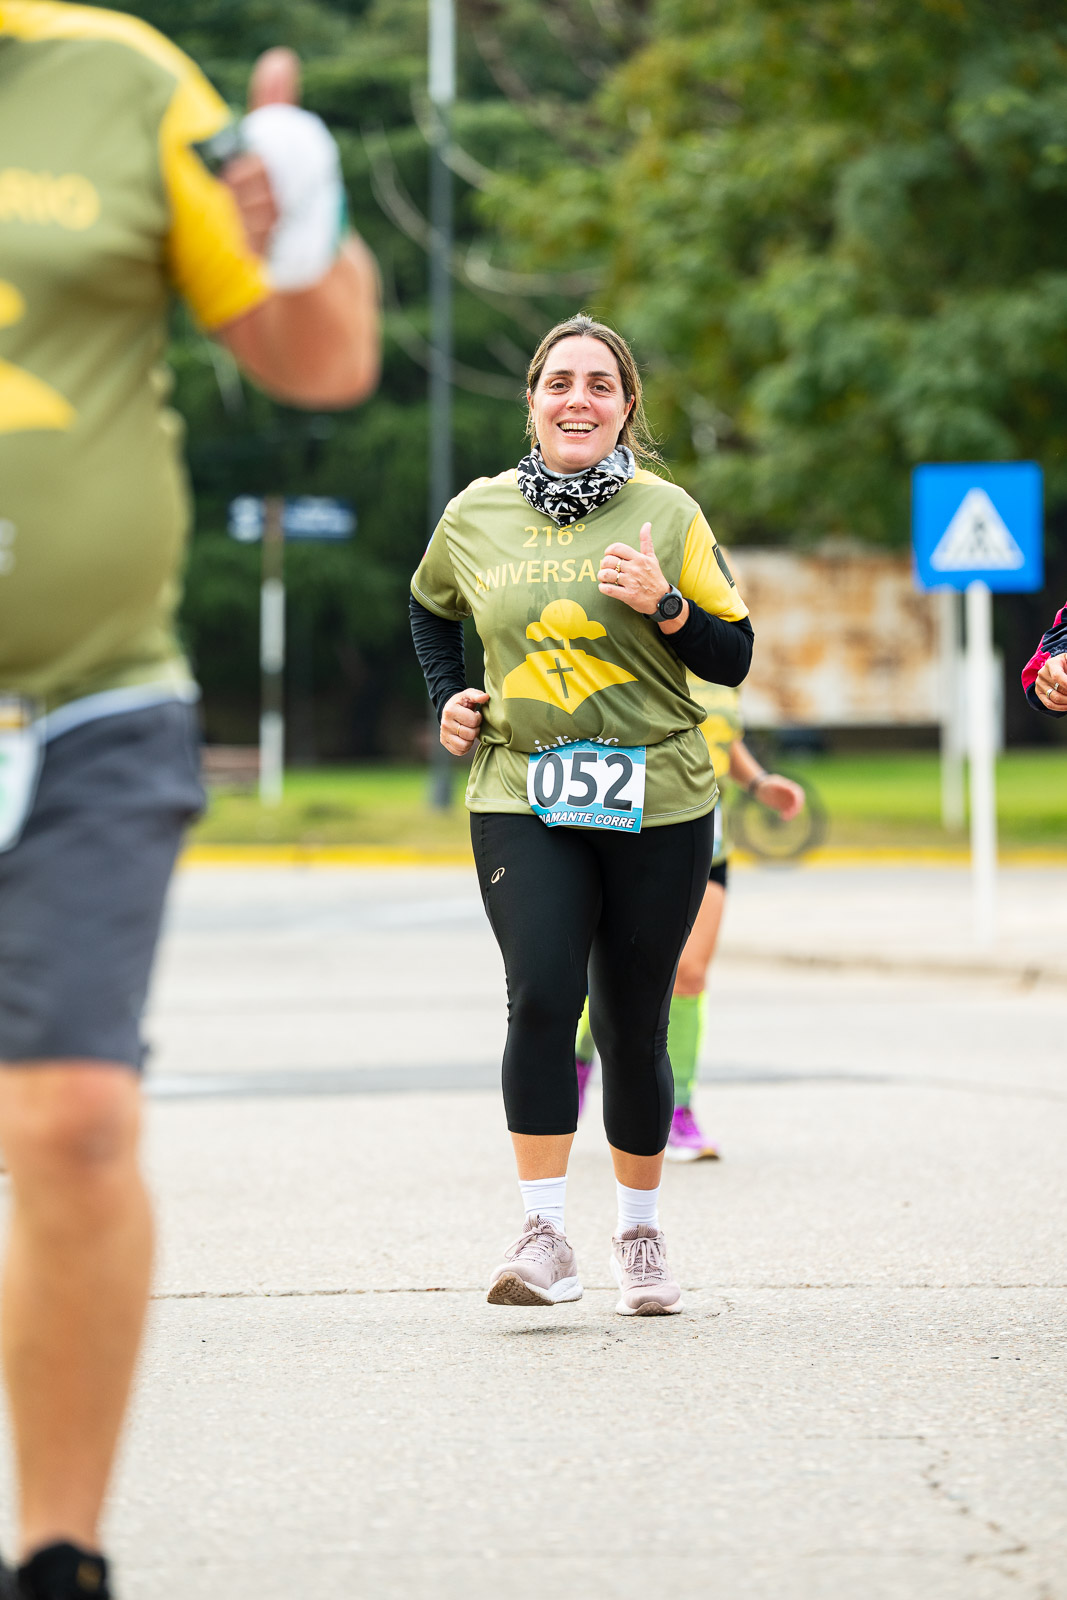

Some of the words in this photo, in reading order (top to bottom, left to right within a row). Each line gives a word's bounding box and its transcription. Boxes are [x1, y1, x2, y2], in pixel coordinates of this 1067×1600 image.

[475, 558, 598, 594] ANIVERSA
[533, 752, 633, 811] 052
[594, 814, 636, 829] CORRE
